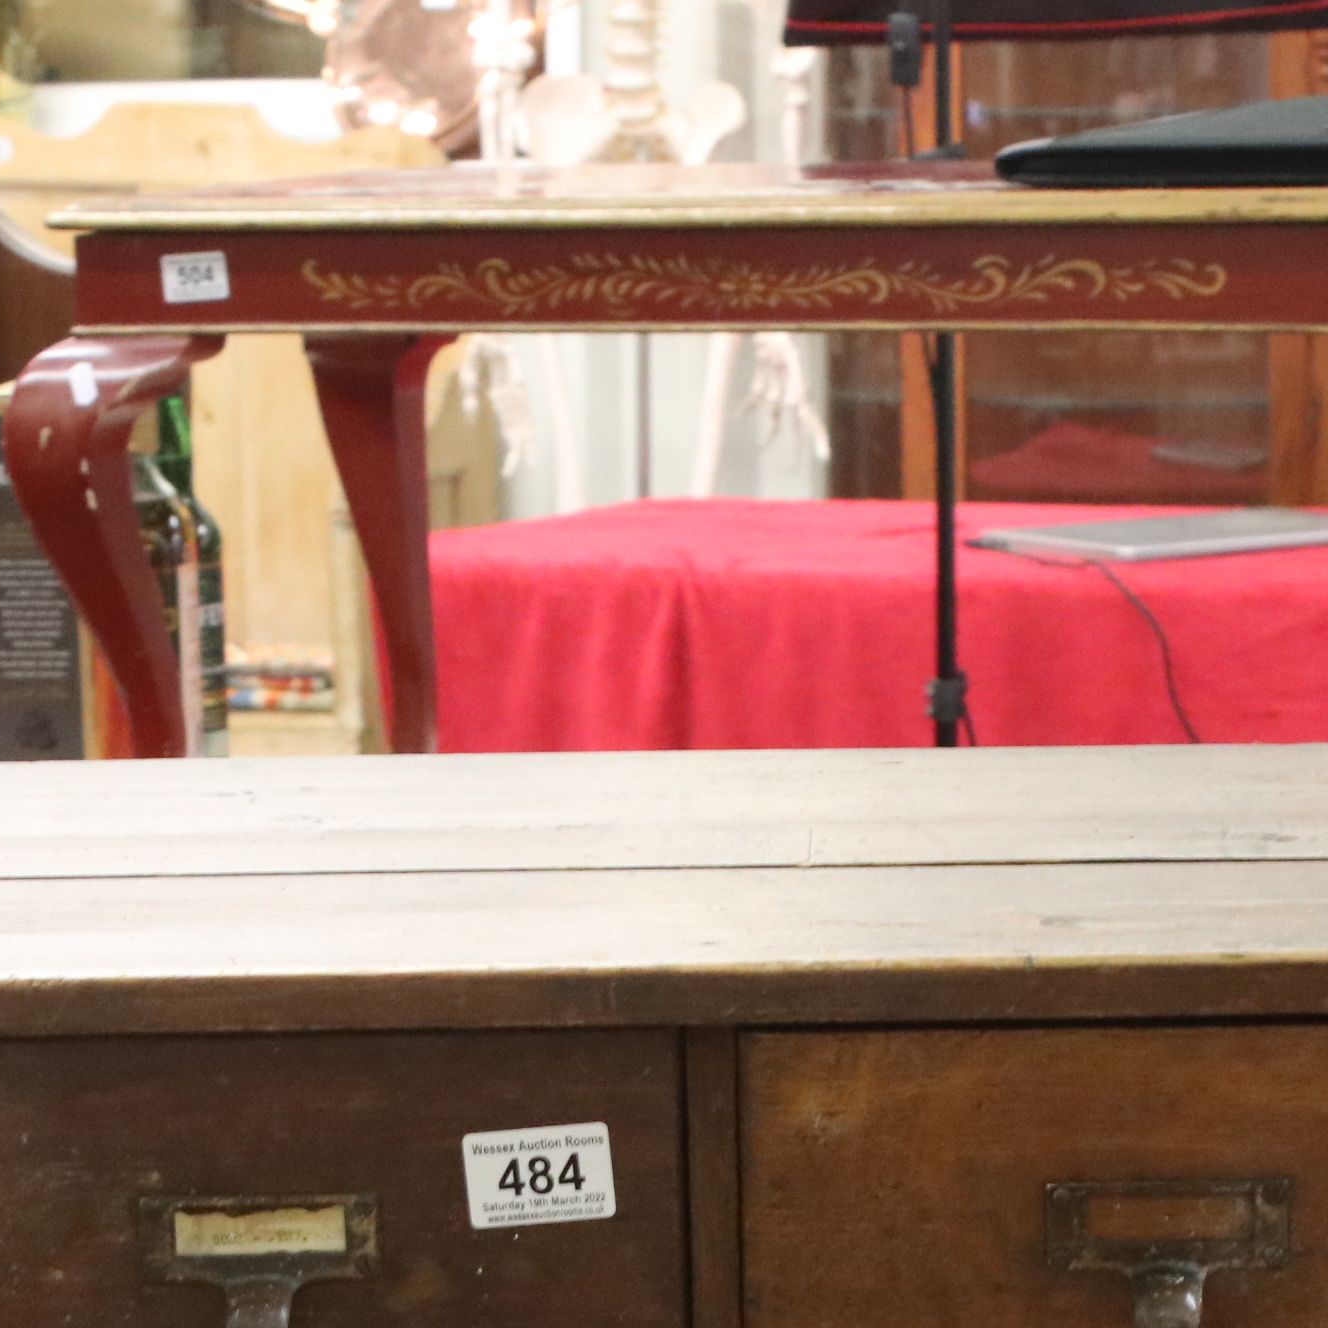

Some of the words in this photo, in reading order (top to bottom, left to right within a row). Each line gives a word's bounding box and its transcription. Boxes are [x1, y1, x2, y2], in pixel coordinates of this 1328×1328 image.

[177, 263, 215, 287] 504
[471, 1143, 515, 1155] Wessex
[519, 1137, 562, 1151] Auction
[565, 1134, 604, 1147] Rooms
[498, 1152, 586, 1196] 484
[482, 1201, 525, 1214] Saturday
[529, 1197, 549, 1208] 19th
[552, 1195, 581, 1206] March
[585, 1193, 607, 1203] 2022
